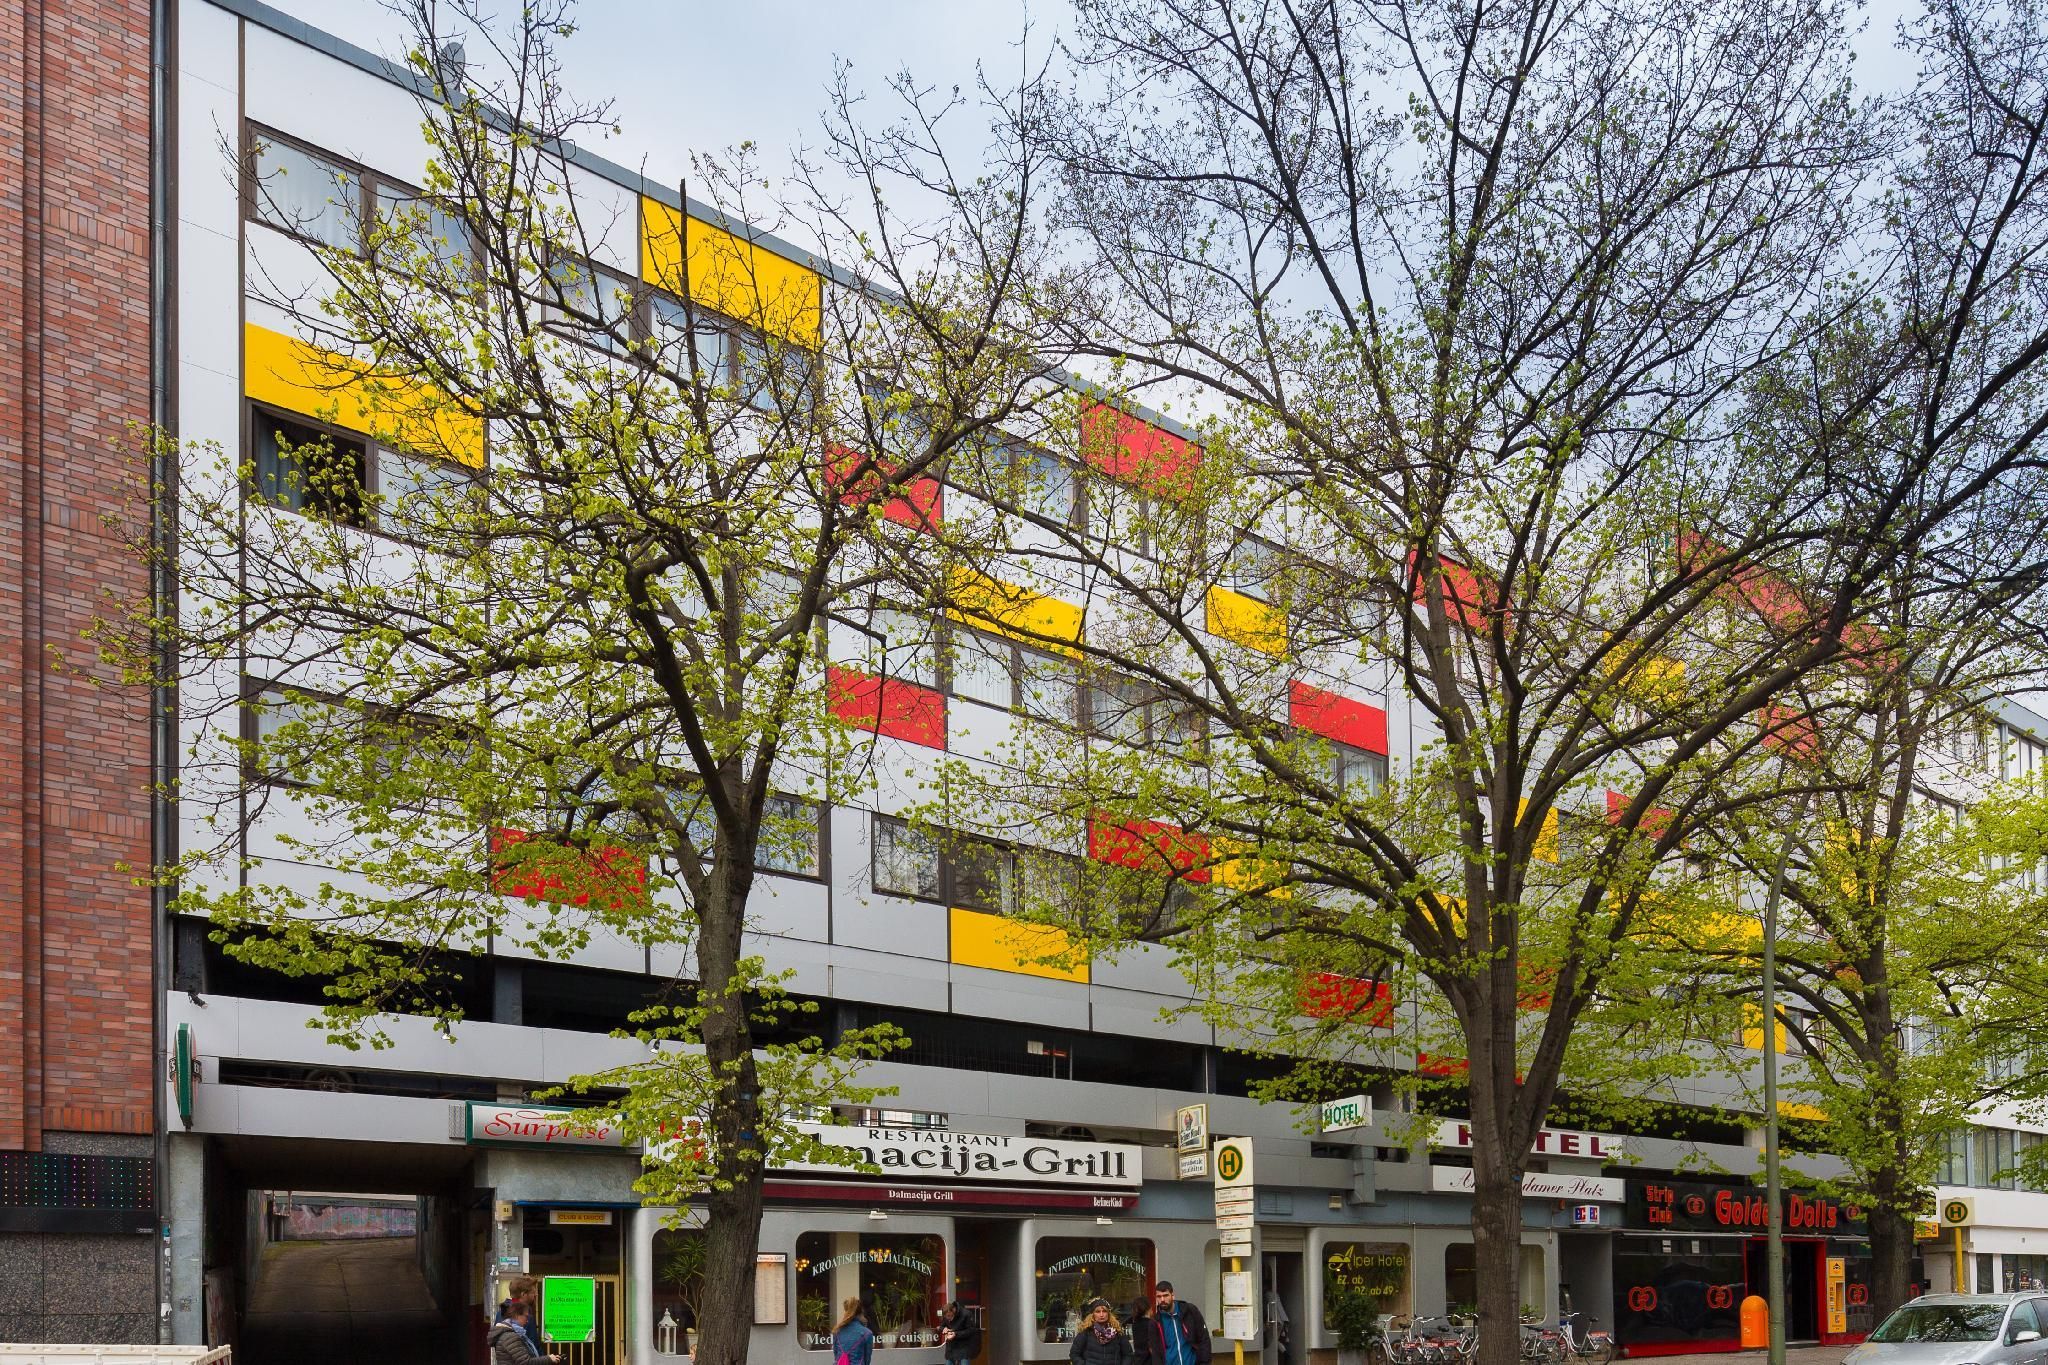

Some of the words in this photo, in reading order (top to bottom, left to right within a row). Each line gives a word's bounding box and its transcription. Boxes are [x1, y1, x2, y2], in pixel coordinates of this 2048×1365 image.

[1324, 1103, 1360, 1125] HOTEL
[869, 1129, 1011, 1148] RESTAURANT
[1458, 1125, 1608, 1157] HTEL
[888, 1189, 931, 1201] Dalmacija
[934, 1191, 953, 1200] Grill
[1568, 1177, 1604, 1196] Platz
[1647, 1186, 1673, 1206] Strip
[1650, 1207, 1672, 1223] Club
[1789, 1193, 1837, 1228] Dolls
[812, 1251, 867, 1277] KROATISCHE
[869, 1251, 932, 1276] SPEZIALITÄTEN
[1048, 1253, 1117, 1277] INTERNATIONALE
[1119, 1256, 1146, 1276] KÜCHE
[1379, 1254, 1406, 1267] Hotel
[901, 1331, 939, 1343] cuisine
